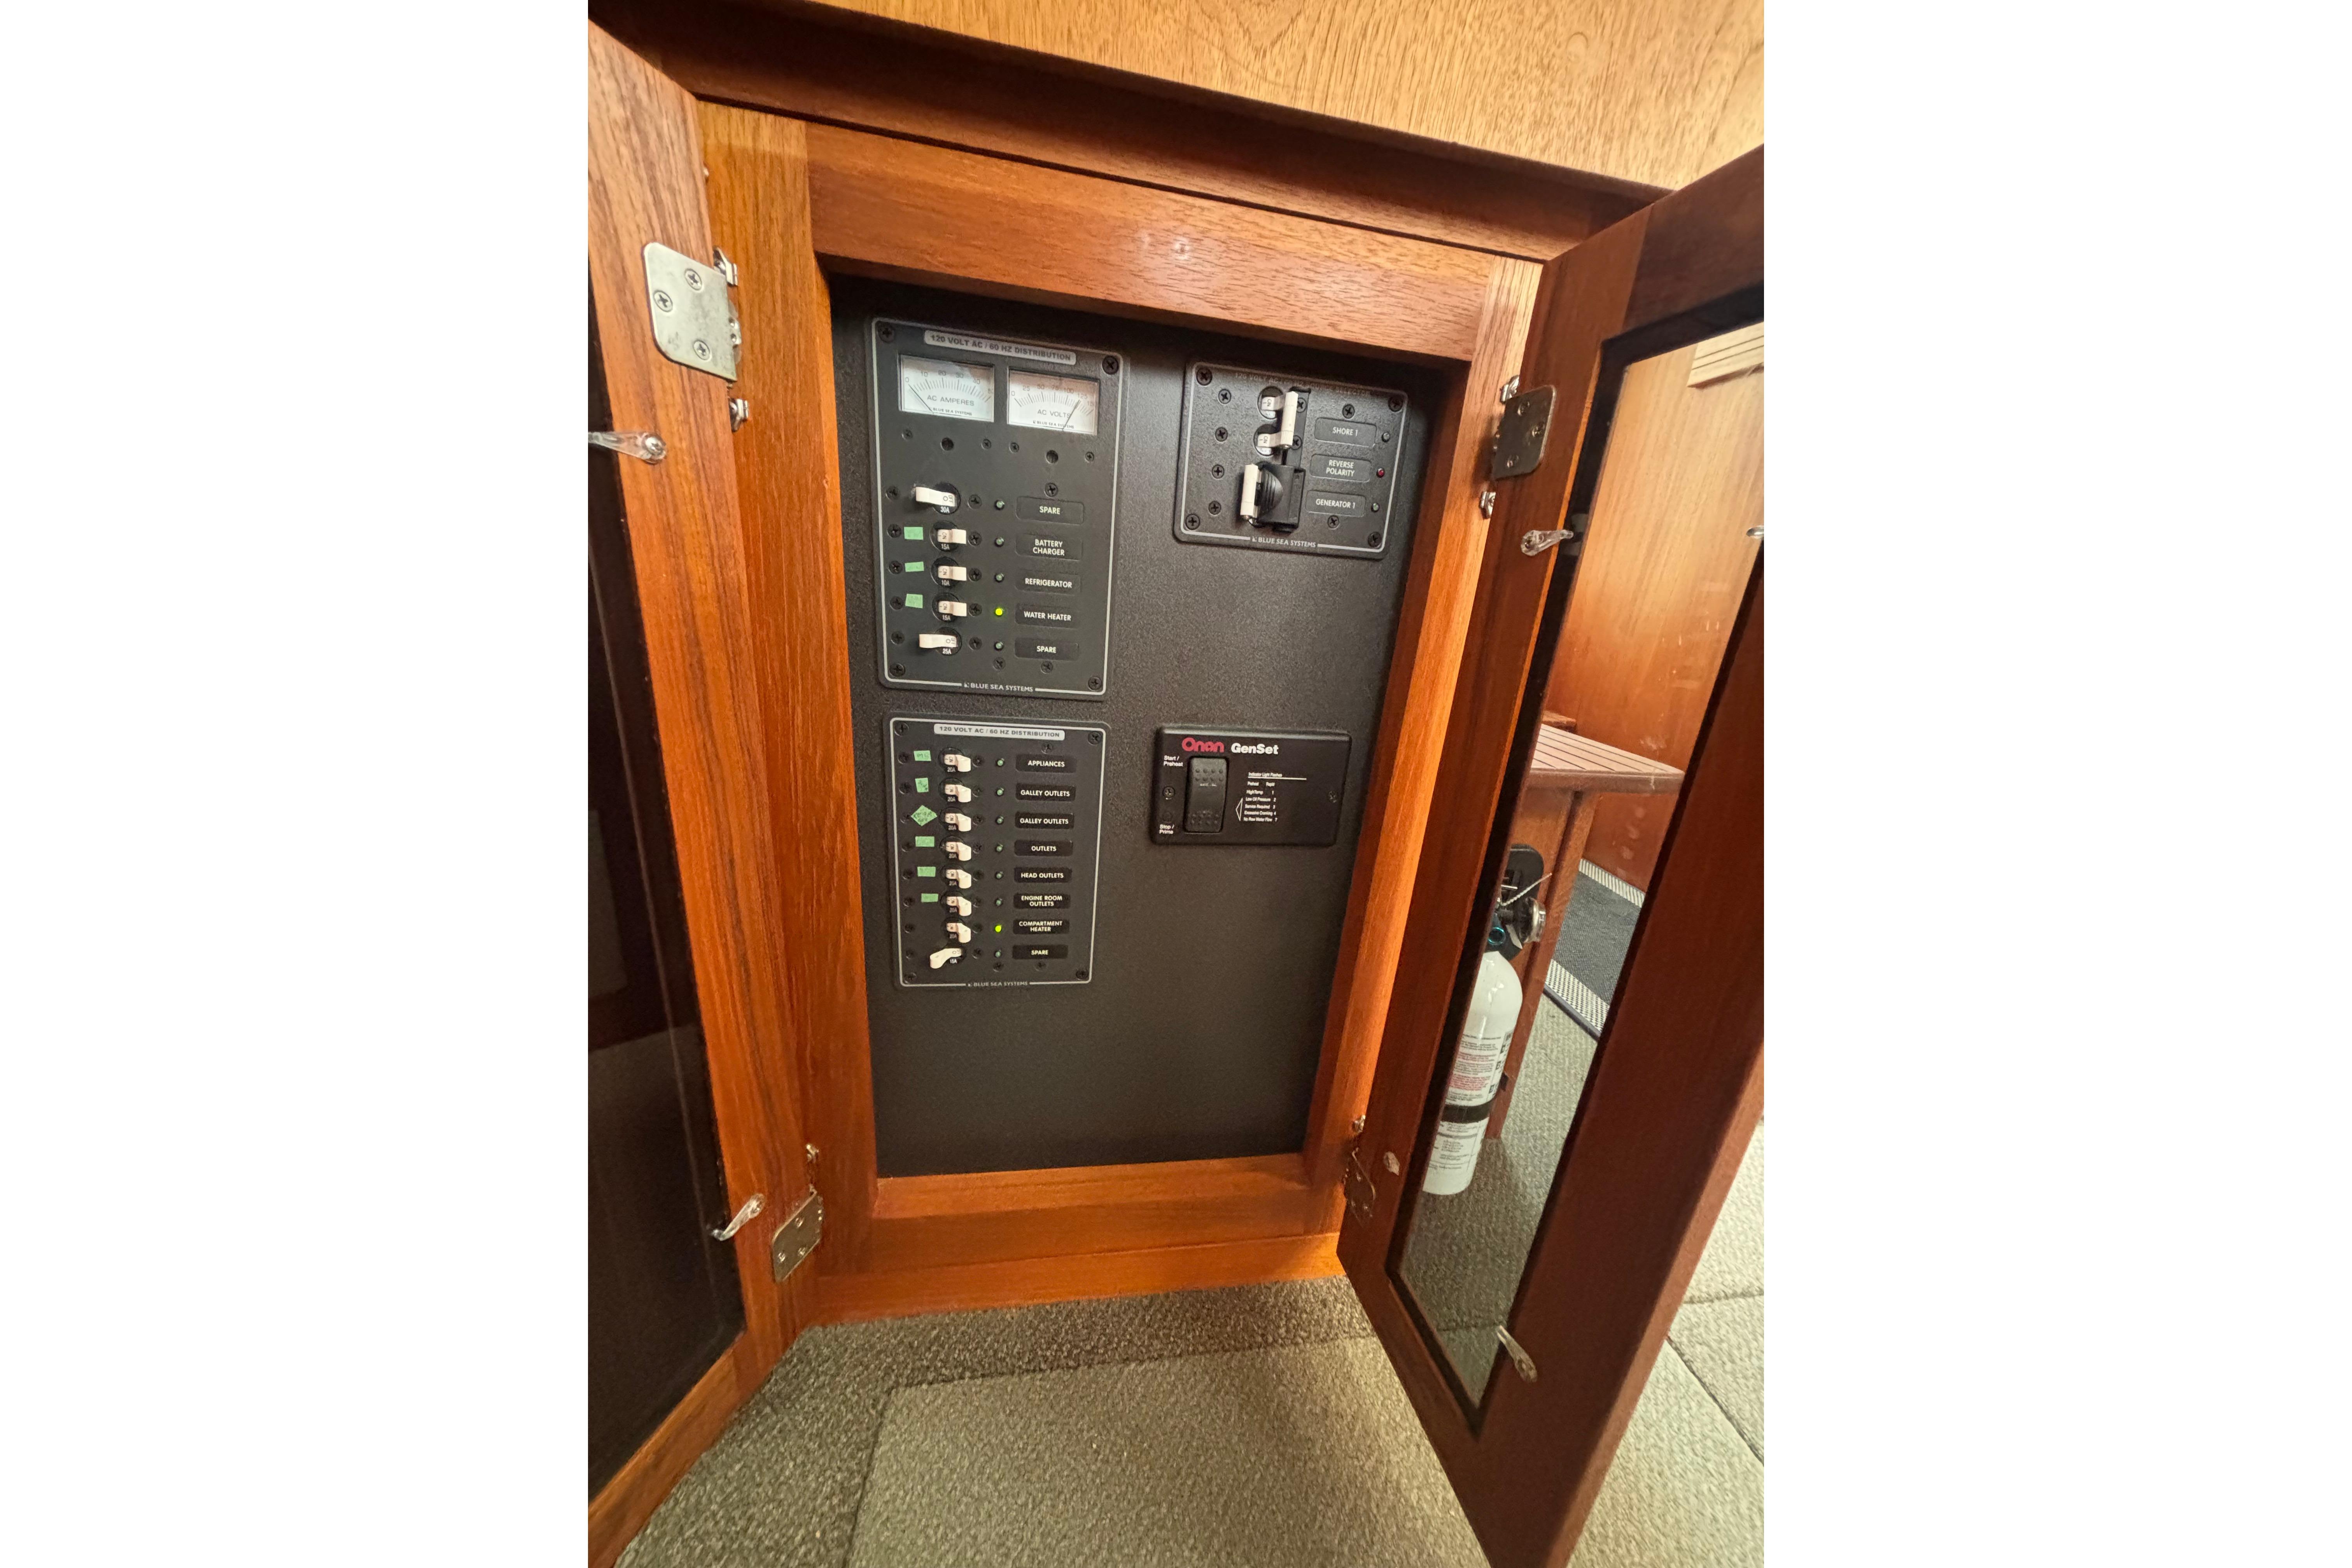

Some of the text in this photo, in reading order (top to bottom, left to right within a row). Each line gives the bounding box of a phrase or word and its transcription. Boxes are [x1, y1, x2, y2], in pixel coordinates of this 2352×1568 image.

[947, 337, 969, 346] VOLT
[1015, 347, 1070, 360] DISTRIBUTION
[940, 397, 974, 406] AMPERES
[1332, 427, 1353, 436] SHORE
[1329, 460, 1354, 469] REVERSE
[1326, 467, 1355, 477] POLARITY
[1316, 499, 1351, 508] GENERATOR
[1040, 506, 1060, 514] SPARE
[1035, 539, 1063, 547] BATTERY
[1032, 547, 1064, 556] CHARGER
[1025, 578, 1072, 588] REFRIGERATOR
[1182, 737, 1224, 753] Onan
[1231, 743, 1279, 754] GenSet
